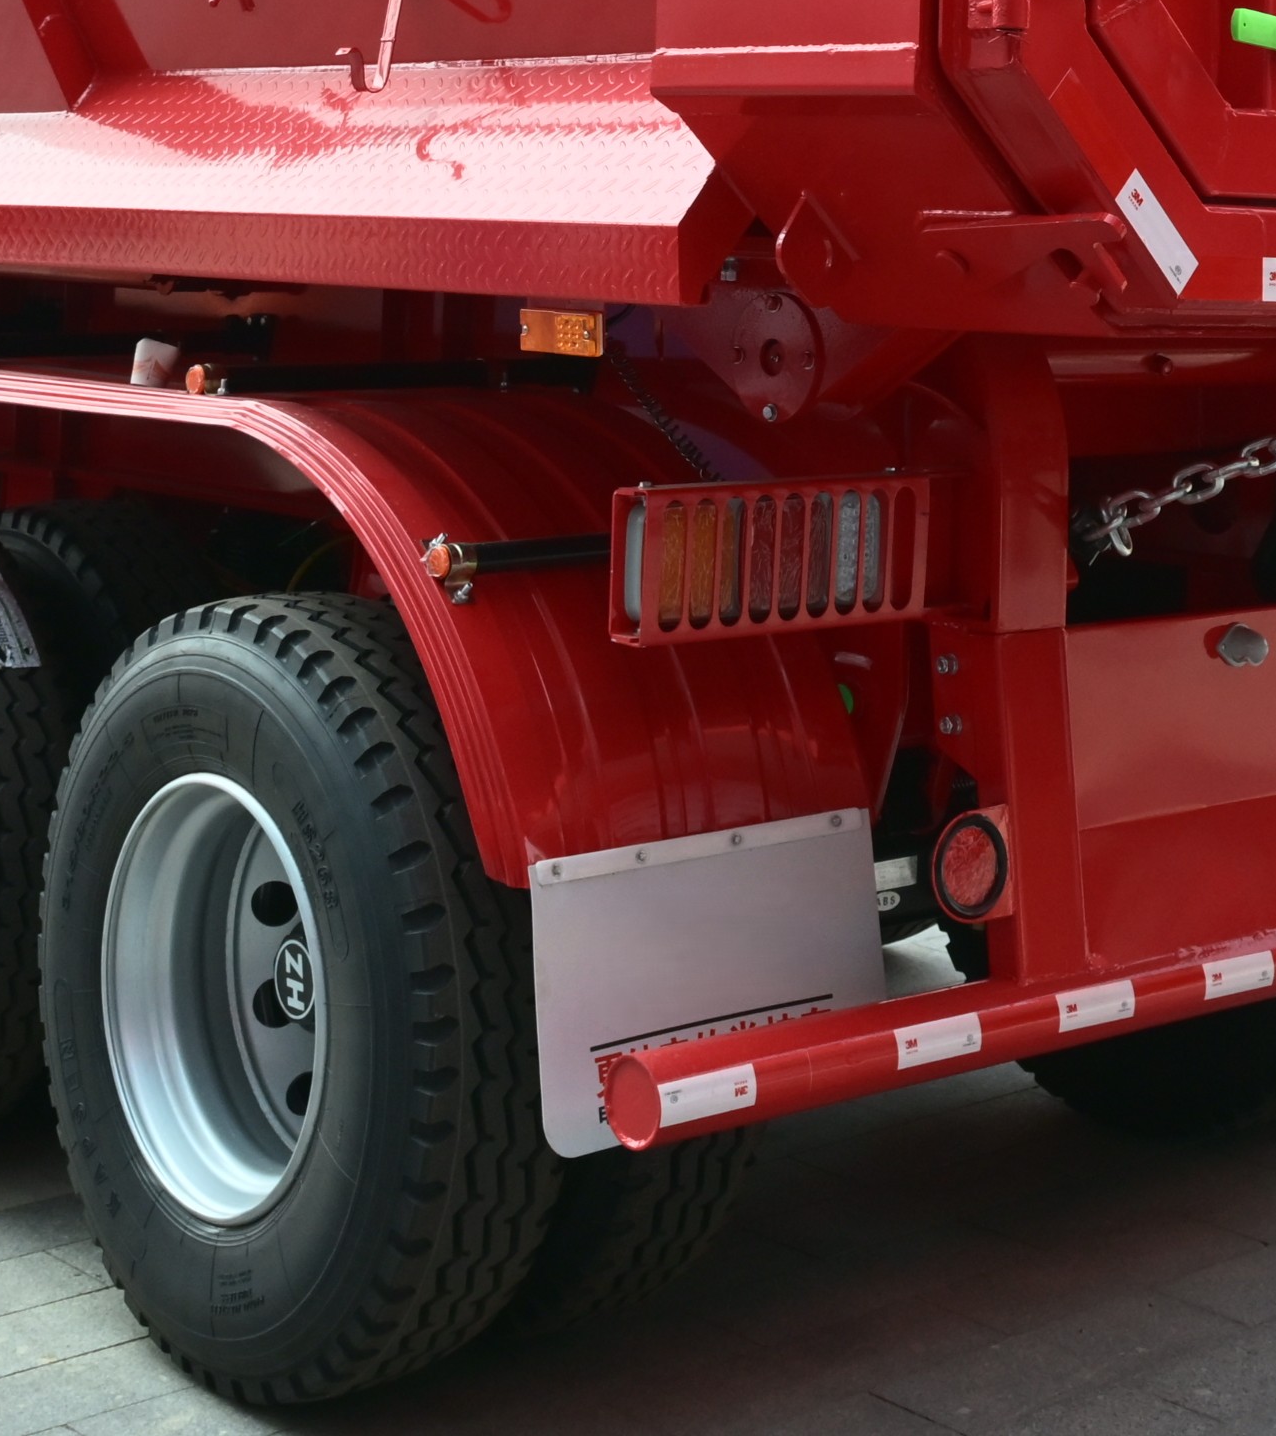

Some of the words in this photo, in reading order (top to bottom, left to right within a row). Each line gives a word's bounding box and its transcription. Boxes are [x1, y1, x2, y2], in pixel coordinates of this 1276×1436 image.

[1131, 188, 1144, 207] 3M
[1211, 972, 1222, 982] 3M
[1065, 1003, 1078, 1014] 3M
[905, 1038, 918, 1050] 3M
[734, 1085, 748, 1097] 3M
